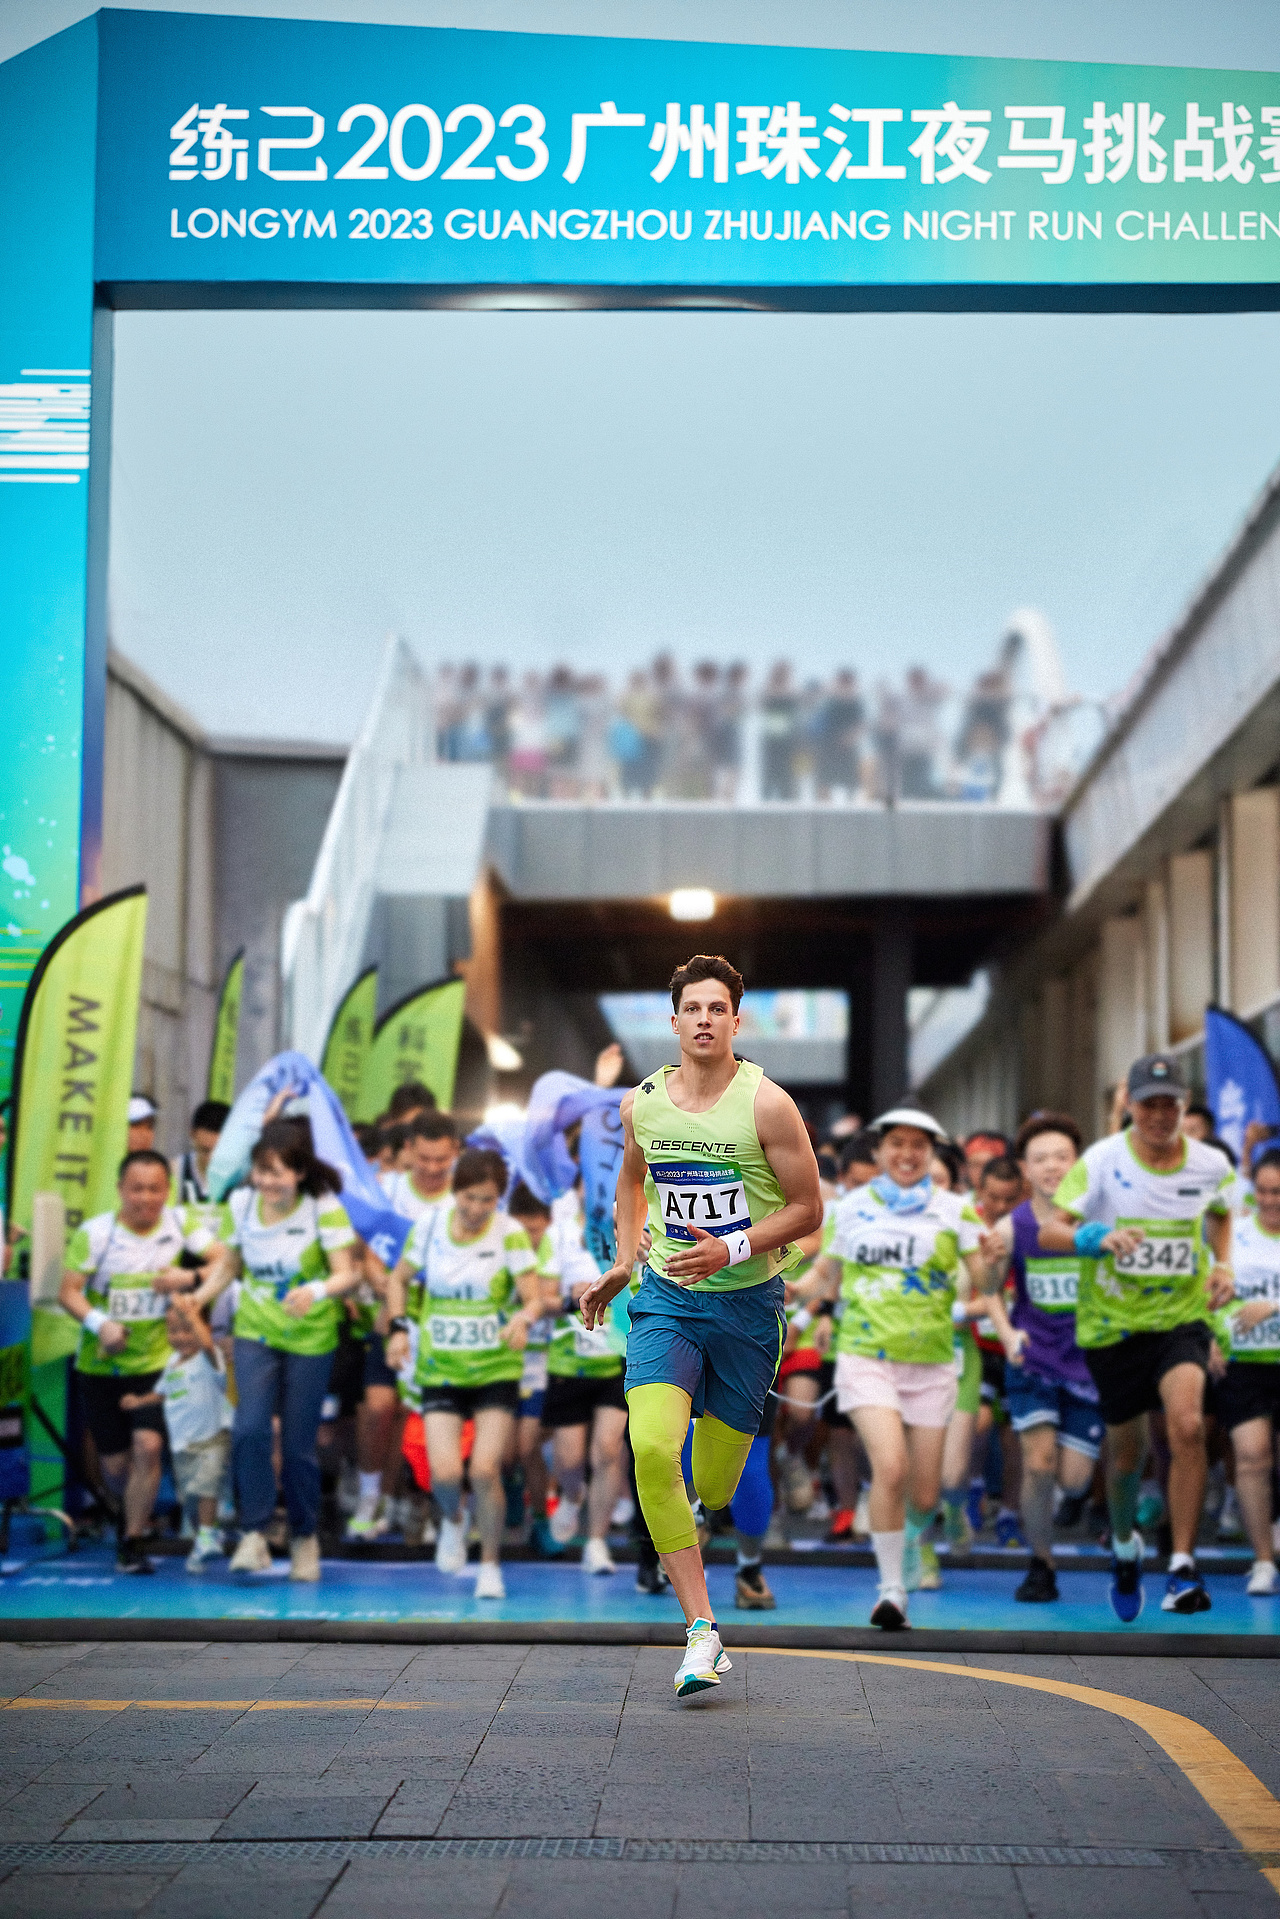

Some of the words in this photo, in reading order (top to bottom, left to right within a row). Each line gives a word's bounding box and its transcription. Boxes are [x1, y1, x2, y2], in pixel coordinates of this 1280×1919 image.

[169, 101, 1280, 185] 练己2023广州珠江夜马挑战
[171, 208, 337, 239] LONGYM
[349, 208, 434, 240] 2023
[445, 208, 692, 241] GUANGZHOU
[703, 209, 891, 241] ZHUJIANG
[903, 209, 1017, 241] NIGHT
[1028, 210, 1102, 241] RUN
[1115, 210, 1280, 241] CHALLEN
[58, 994, 100, 1133] MAKE
[650, 1139, 737, 1154] DESCENTE
[54, 1153, 90, 1188] IT
[665, 1188, 740, 1220] A717
[431, 1317, 498, 1346] B230
